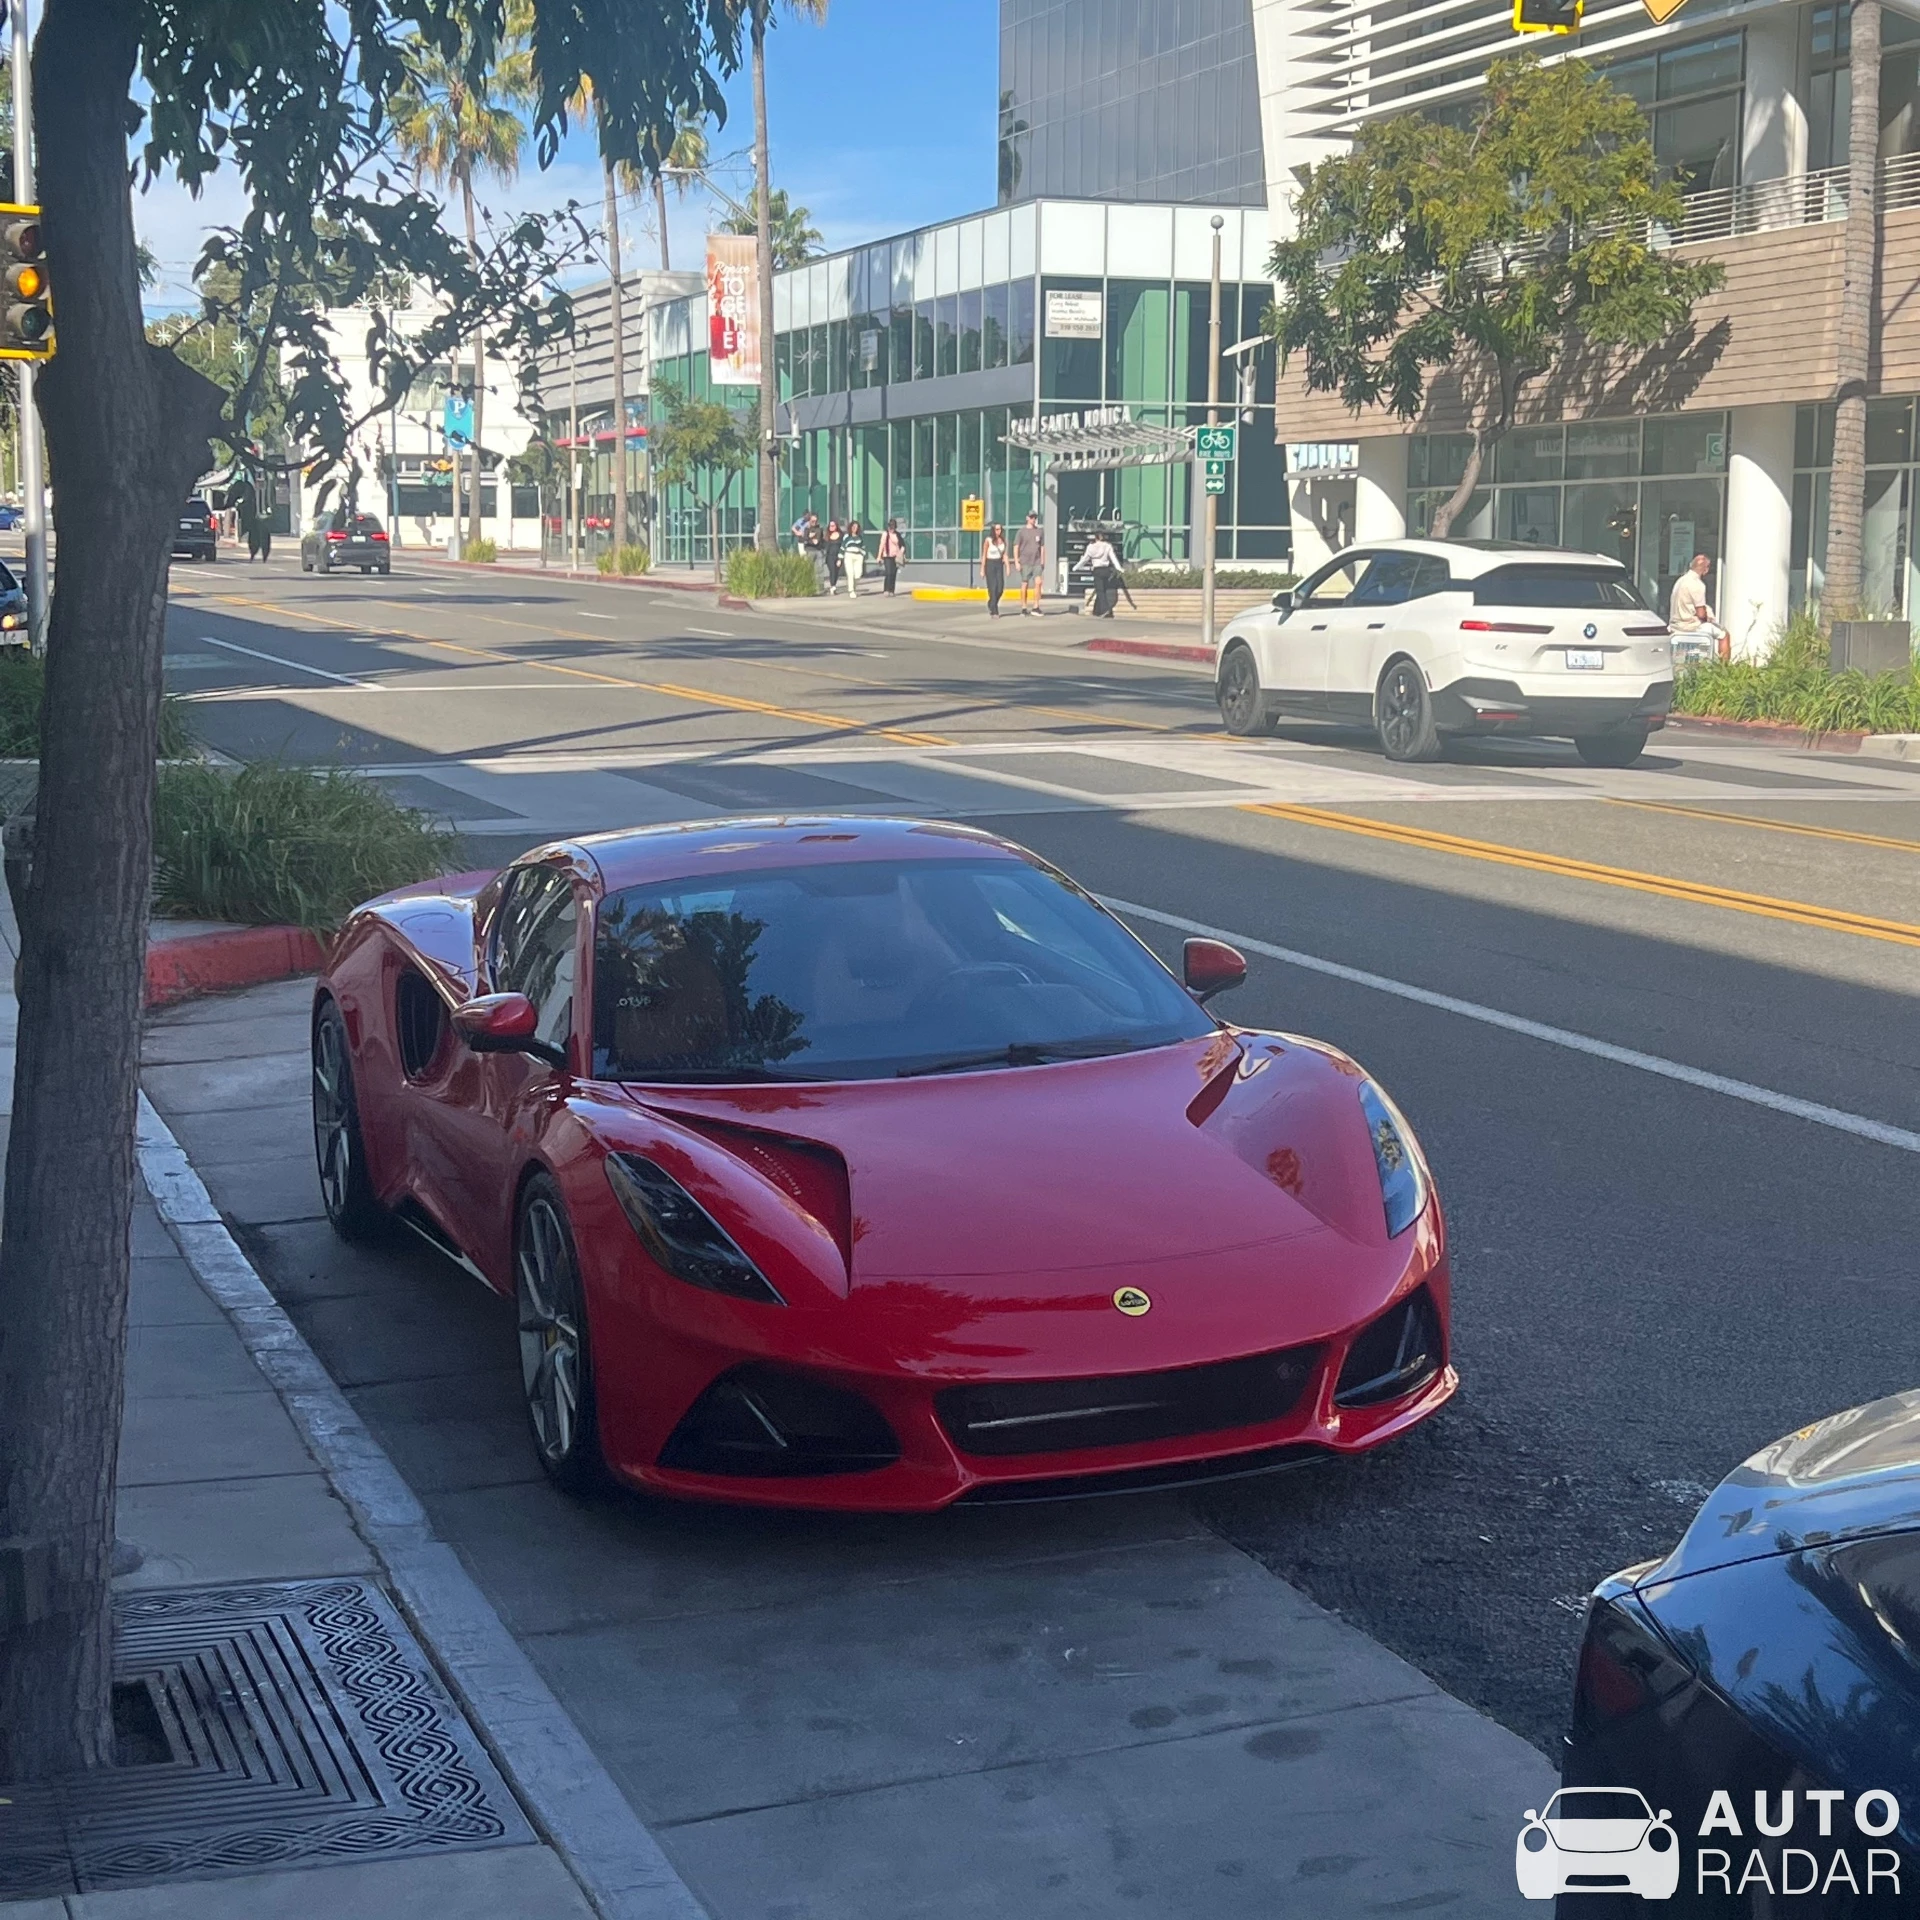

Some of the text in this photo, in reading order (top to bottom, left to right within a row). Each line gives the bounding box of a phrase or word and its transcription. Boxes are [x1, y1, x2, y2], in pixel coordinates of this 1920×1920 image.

[720, 277, 745, 296] TO
[720, 296, 746, 314] GE
[723, 314, 746, 331] TH
[723, 331, 746, 349] ER
[1040, 411, 1080, 434] SANTA
[1084, 405, 1132, 429] MONICA
